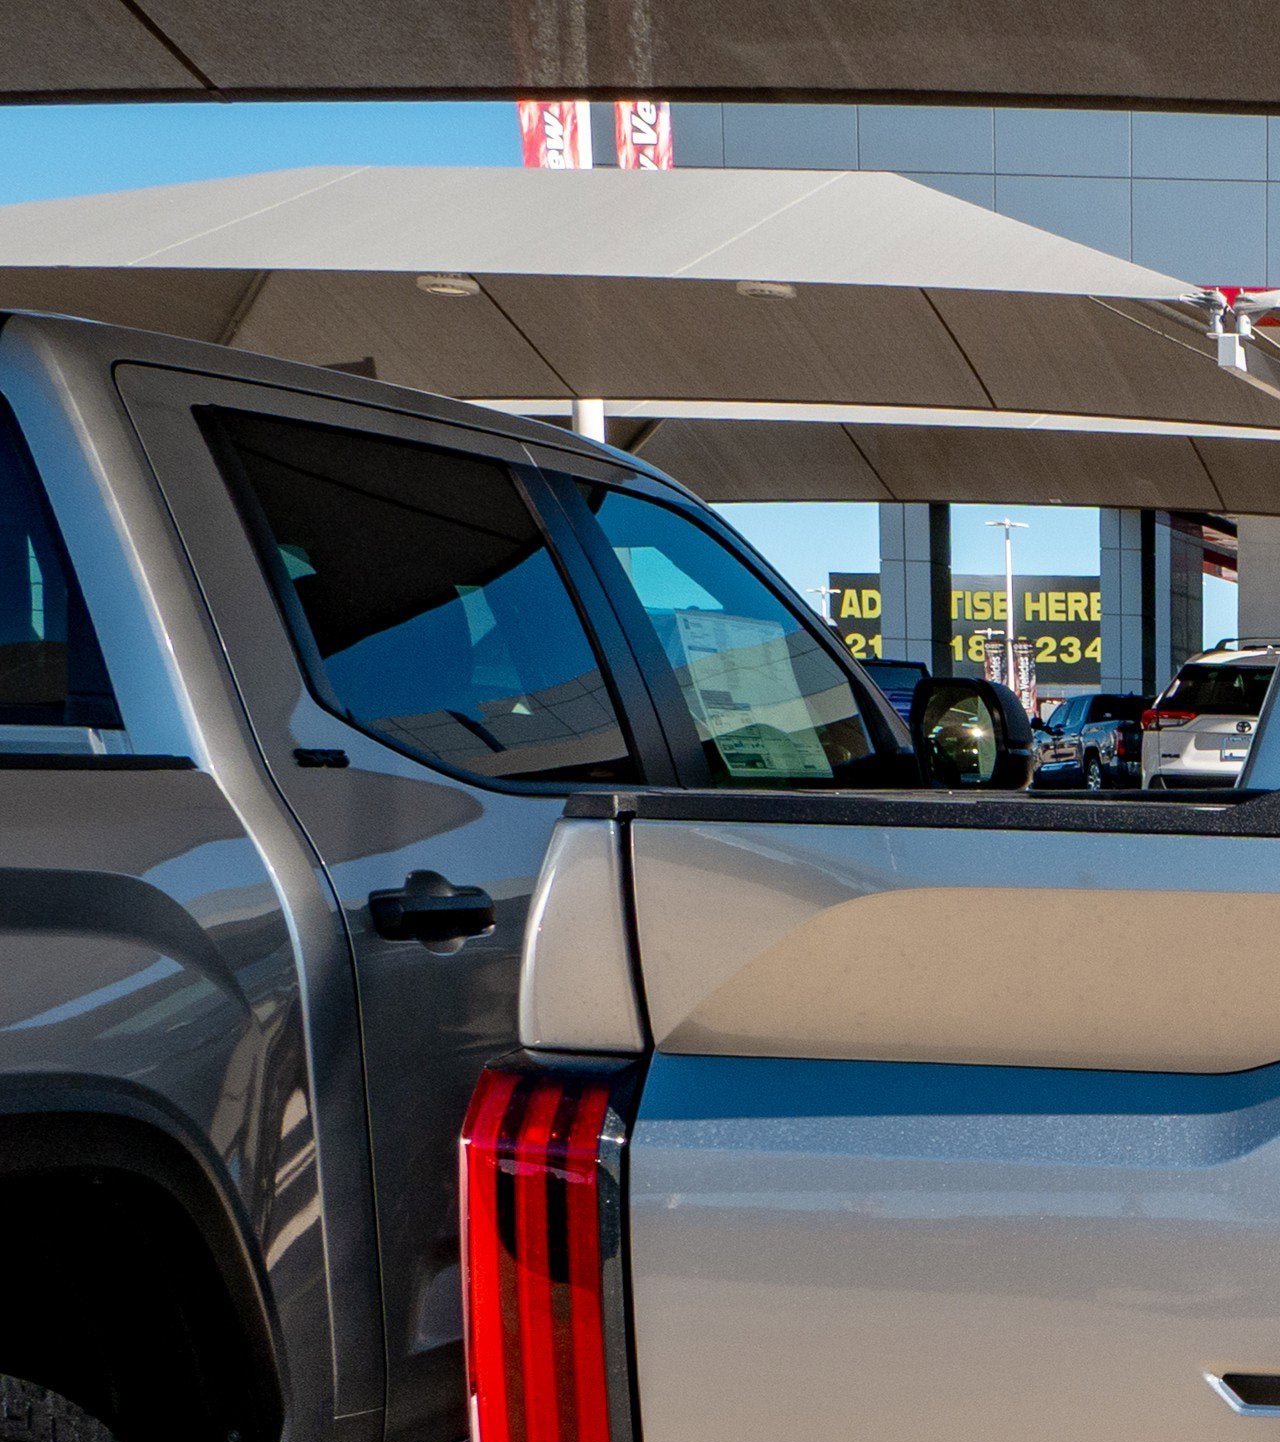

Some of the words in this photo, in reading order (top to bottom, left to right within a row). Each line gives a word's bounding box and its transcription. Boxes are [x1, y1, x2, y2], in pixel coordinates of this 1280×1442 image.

[543, 110, 566, 169] ew
[1025, 591, 1101, 621] HERE
[845, 633, 882, 658] 21
